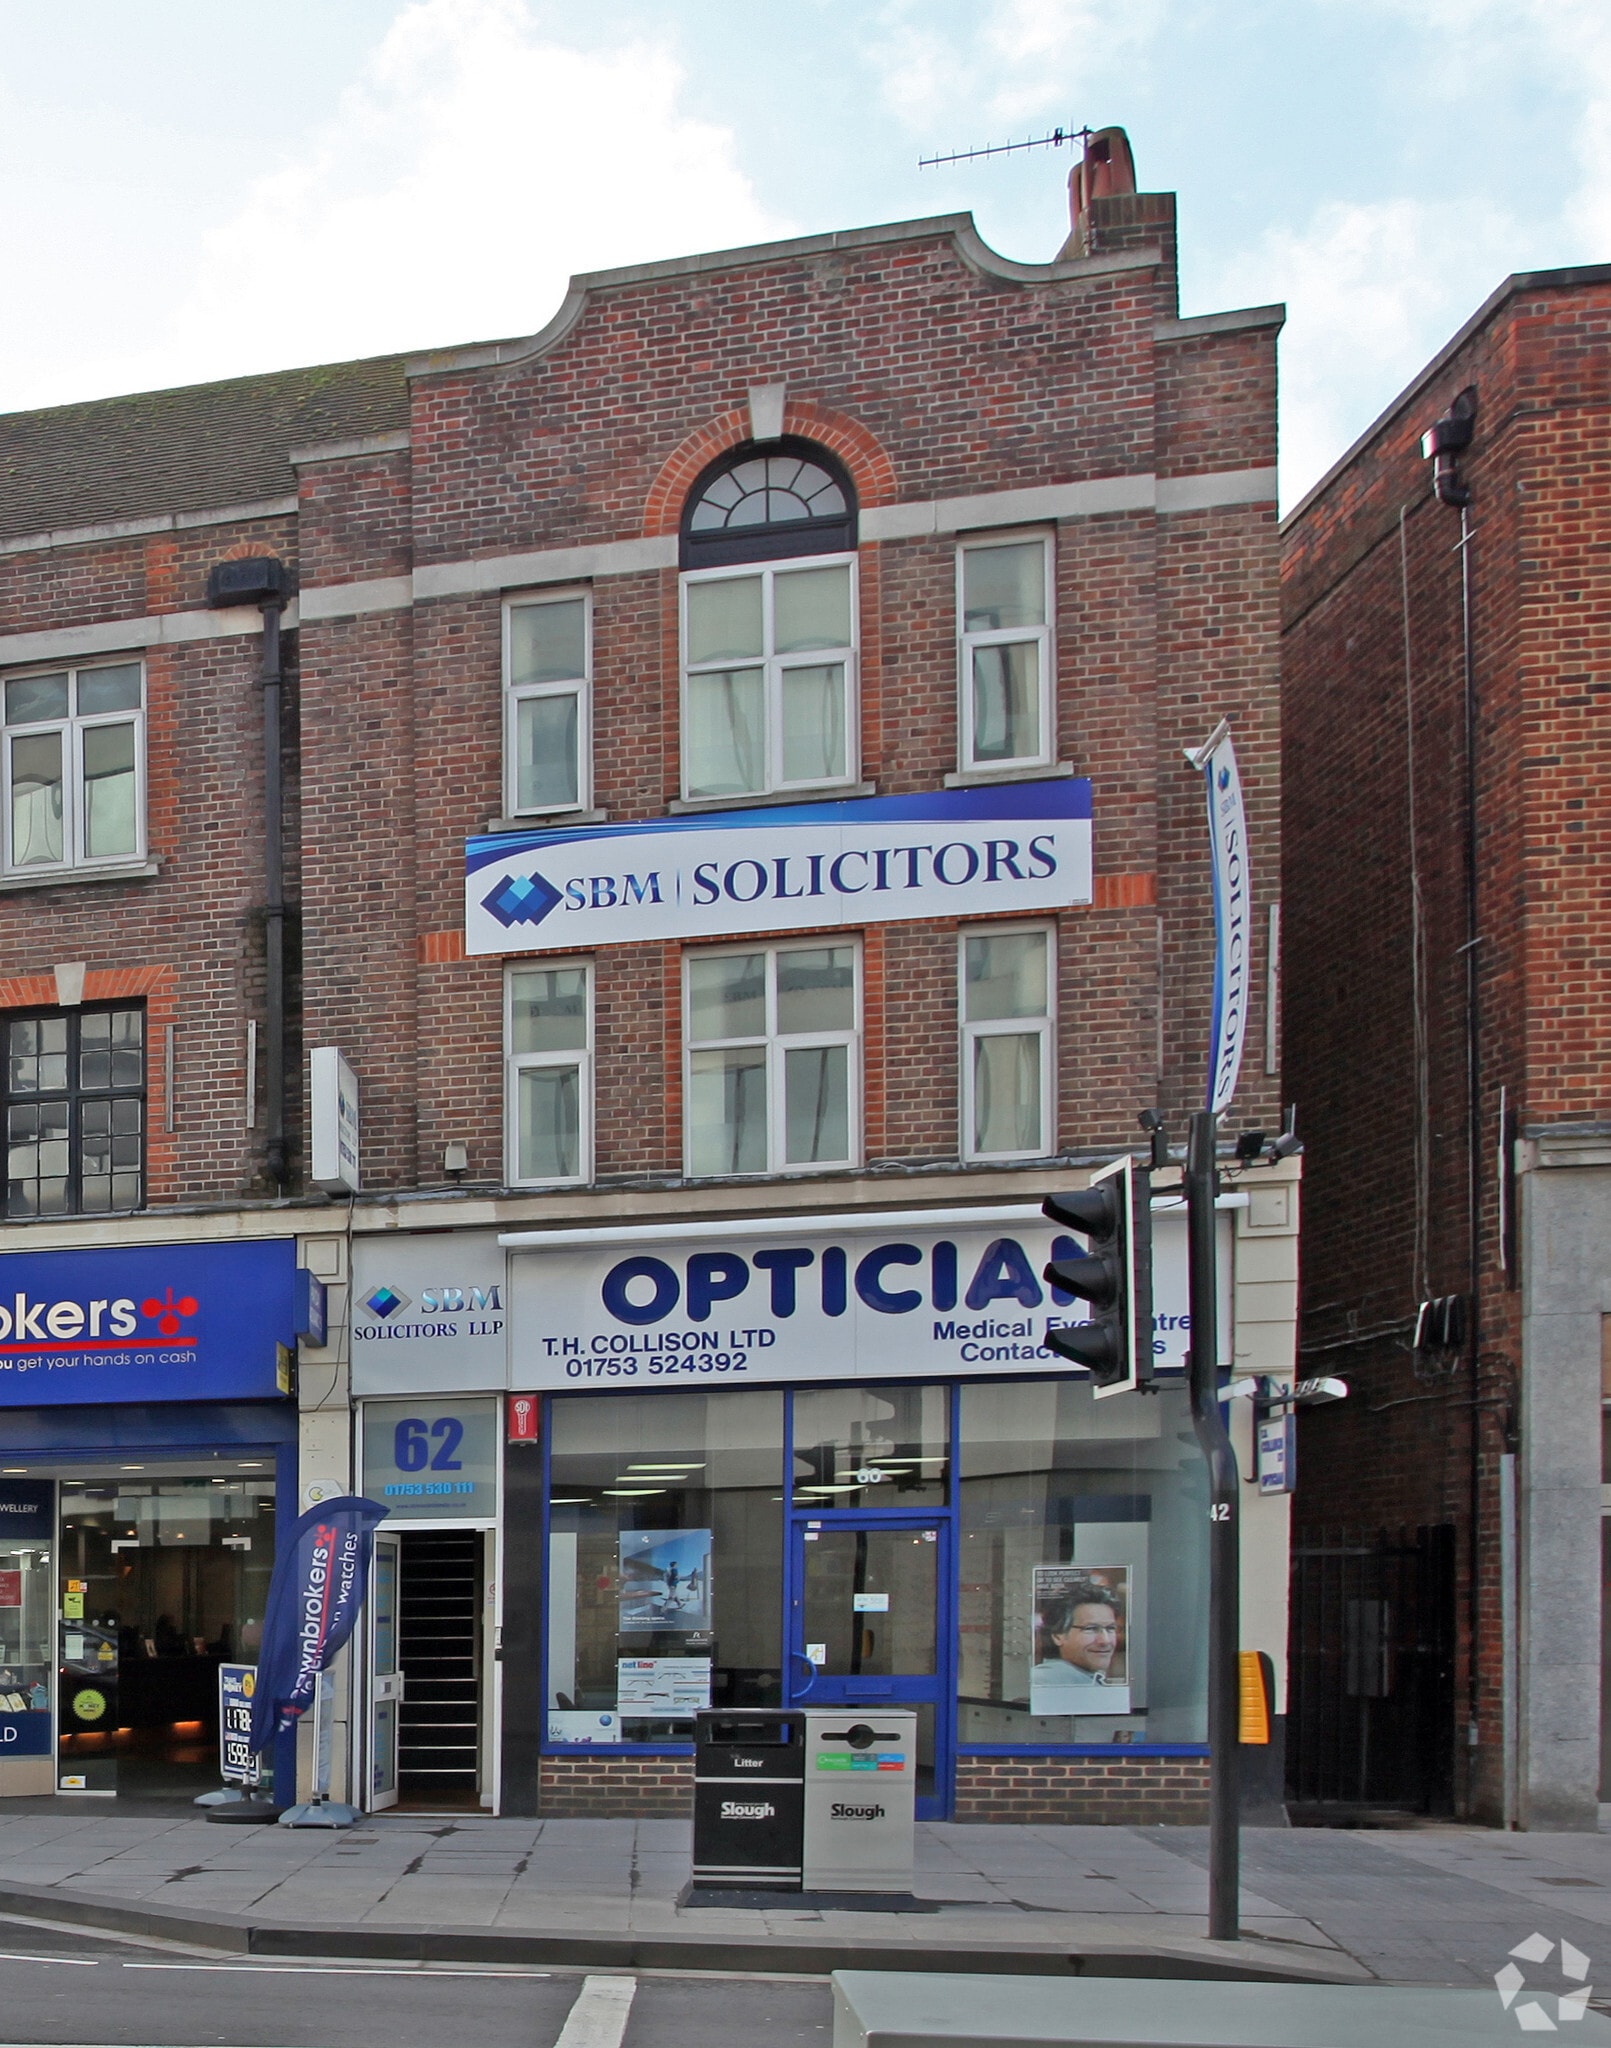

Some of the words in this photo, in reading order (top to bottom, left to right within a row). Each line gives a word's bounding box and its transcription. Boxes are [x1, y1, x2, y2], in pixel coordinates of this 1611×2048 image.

[564, 871, 663, 911] SBM
[693, 835, 1058, 905] SOLICITORS
[1218, 830, 1241, 1098] SOLICITORS
[420, 1284, 503, 1314] SBM
[354, 1322, 457, 1341] SOLICITORS
[468, 1320, 504, 1336] LLP
[933, 1318, 1032, 1341] Medical
[542, 1336, 586, 1357] T.H.
[591, 1331, 719, 1354] COLLISON
[729, 1328, 776, 1349] LTD
[960, 1342, 1061, 1362] Contac
[17, 1355, 43, 1372] get
[46, 1356, 79, 1370] your
[83, 1353, 131, 1367] hands
[136, 1352, 155, 1364] on
[159, 1350, 197, 1364] cash
[566, 1359, 638, 1378] 01753
[647, 1352, 748, 1374] 524392
[394, 1417, 464, 1472] 62
[857, 1467, 882, 1484] 60
[383, 1483, 423, 1497] 01753
[425, 1481, 452, 1495] 530
[454, 1481, 475, 1494] 111
[1210, 1502, 1231, 1522] 42
[336, 1532, 359, 1605] watches
[734, 1757, 763, 1768] Litter
[721, 1801, 775, 1819] Slough
[830, 1803, 885, 1821] Slough
